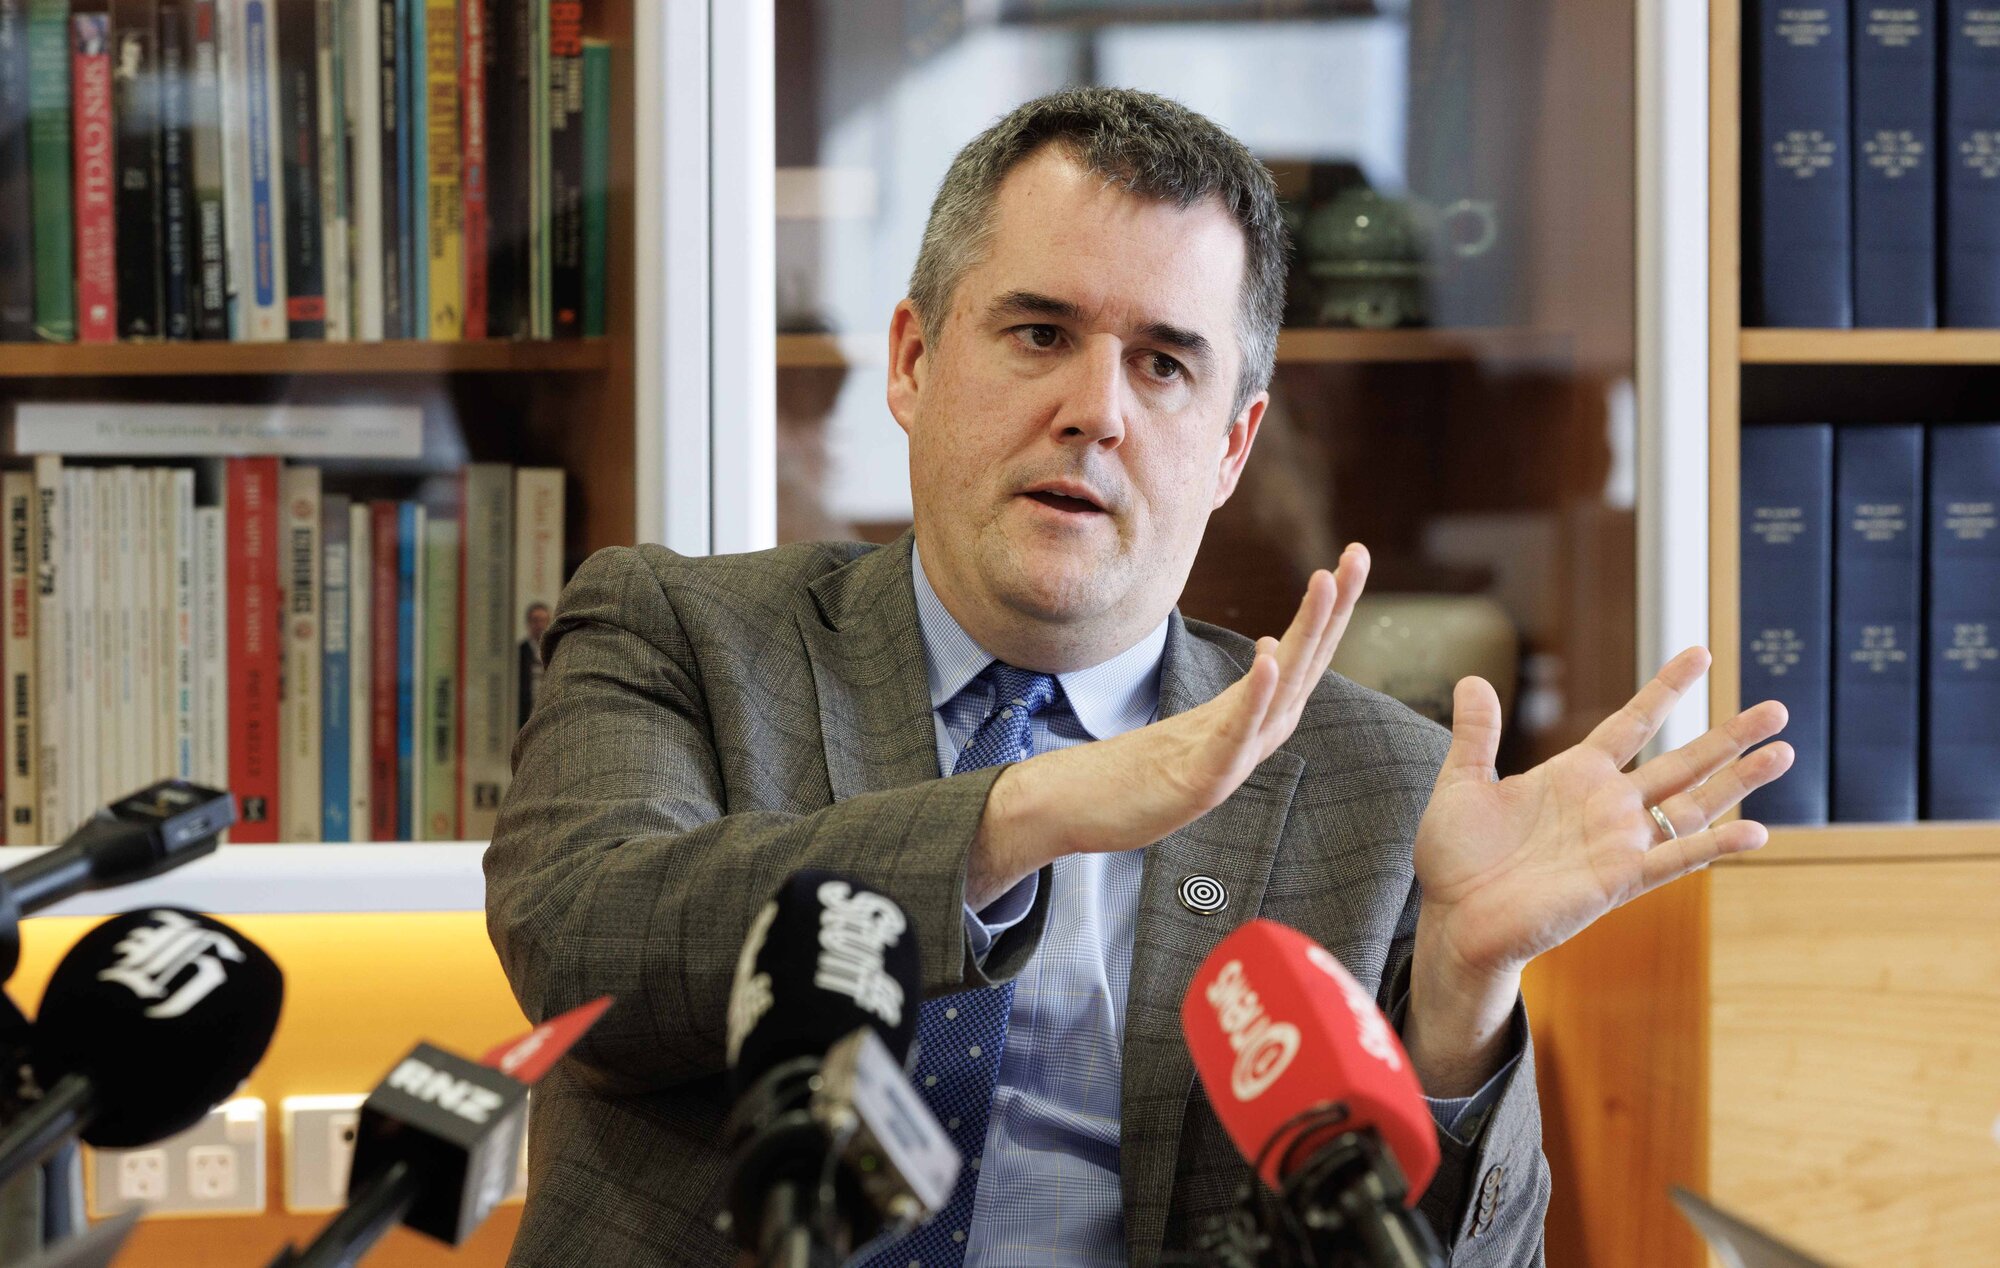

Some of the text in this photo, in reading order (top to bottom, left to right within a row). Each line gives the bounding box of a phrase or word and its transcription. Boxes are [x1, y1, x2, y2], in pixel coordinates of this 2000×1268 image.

[551, 1, 582, 56] BIG
[427, 7, 457, 178] BEER NATION
[83, 59, 108, 206] SPIN CYCLE
[12, 526, 29, 573] PARTY
[40, 488, 55, 564] Election
[387, 1056, 503, 1125] RNZ
